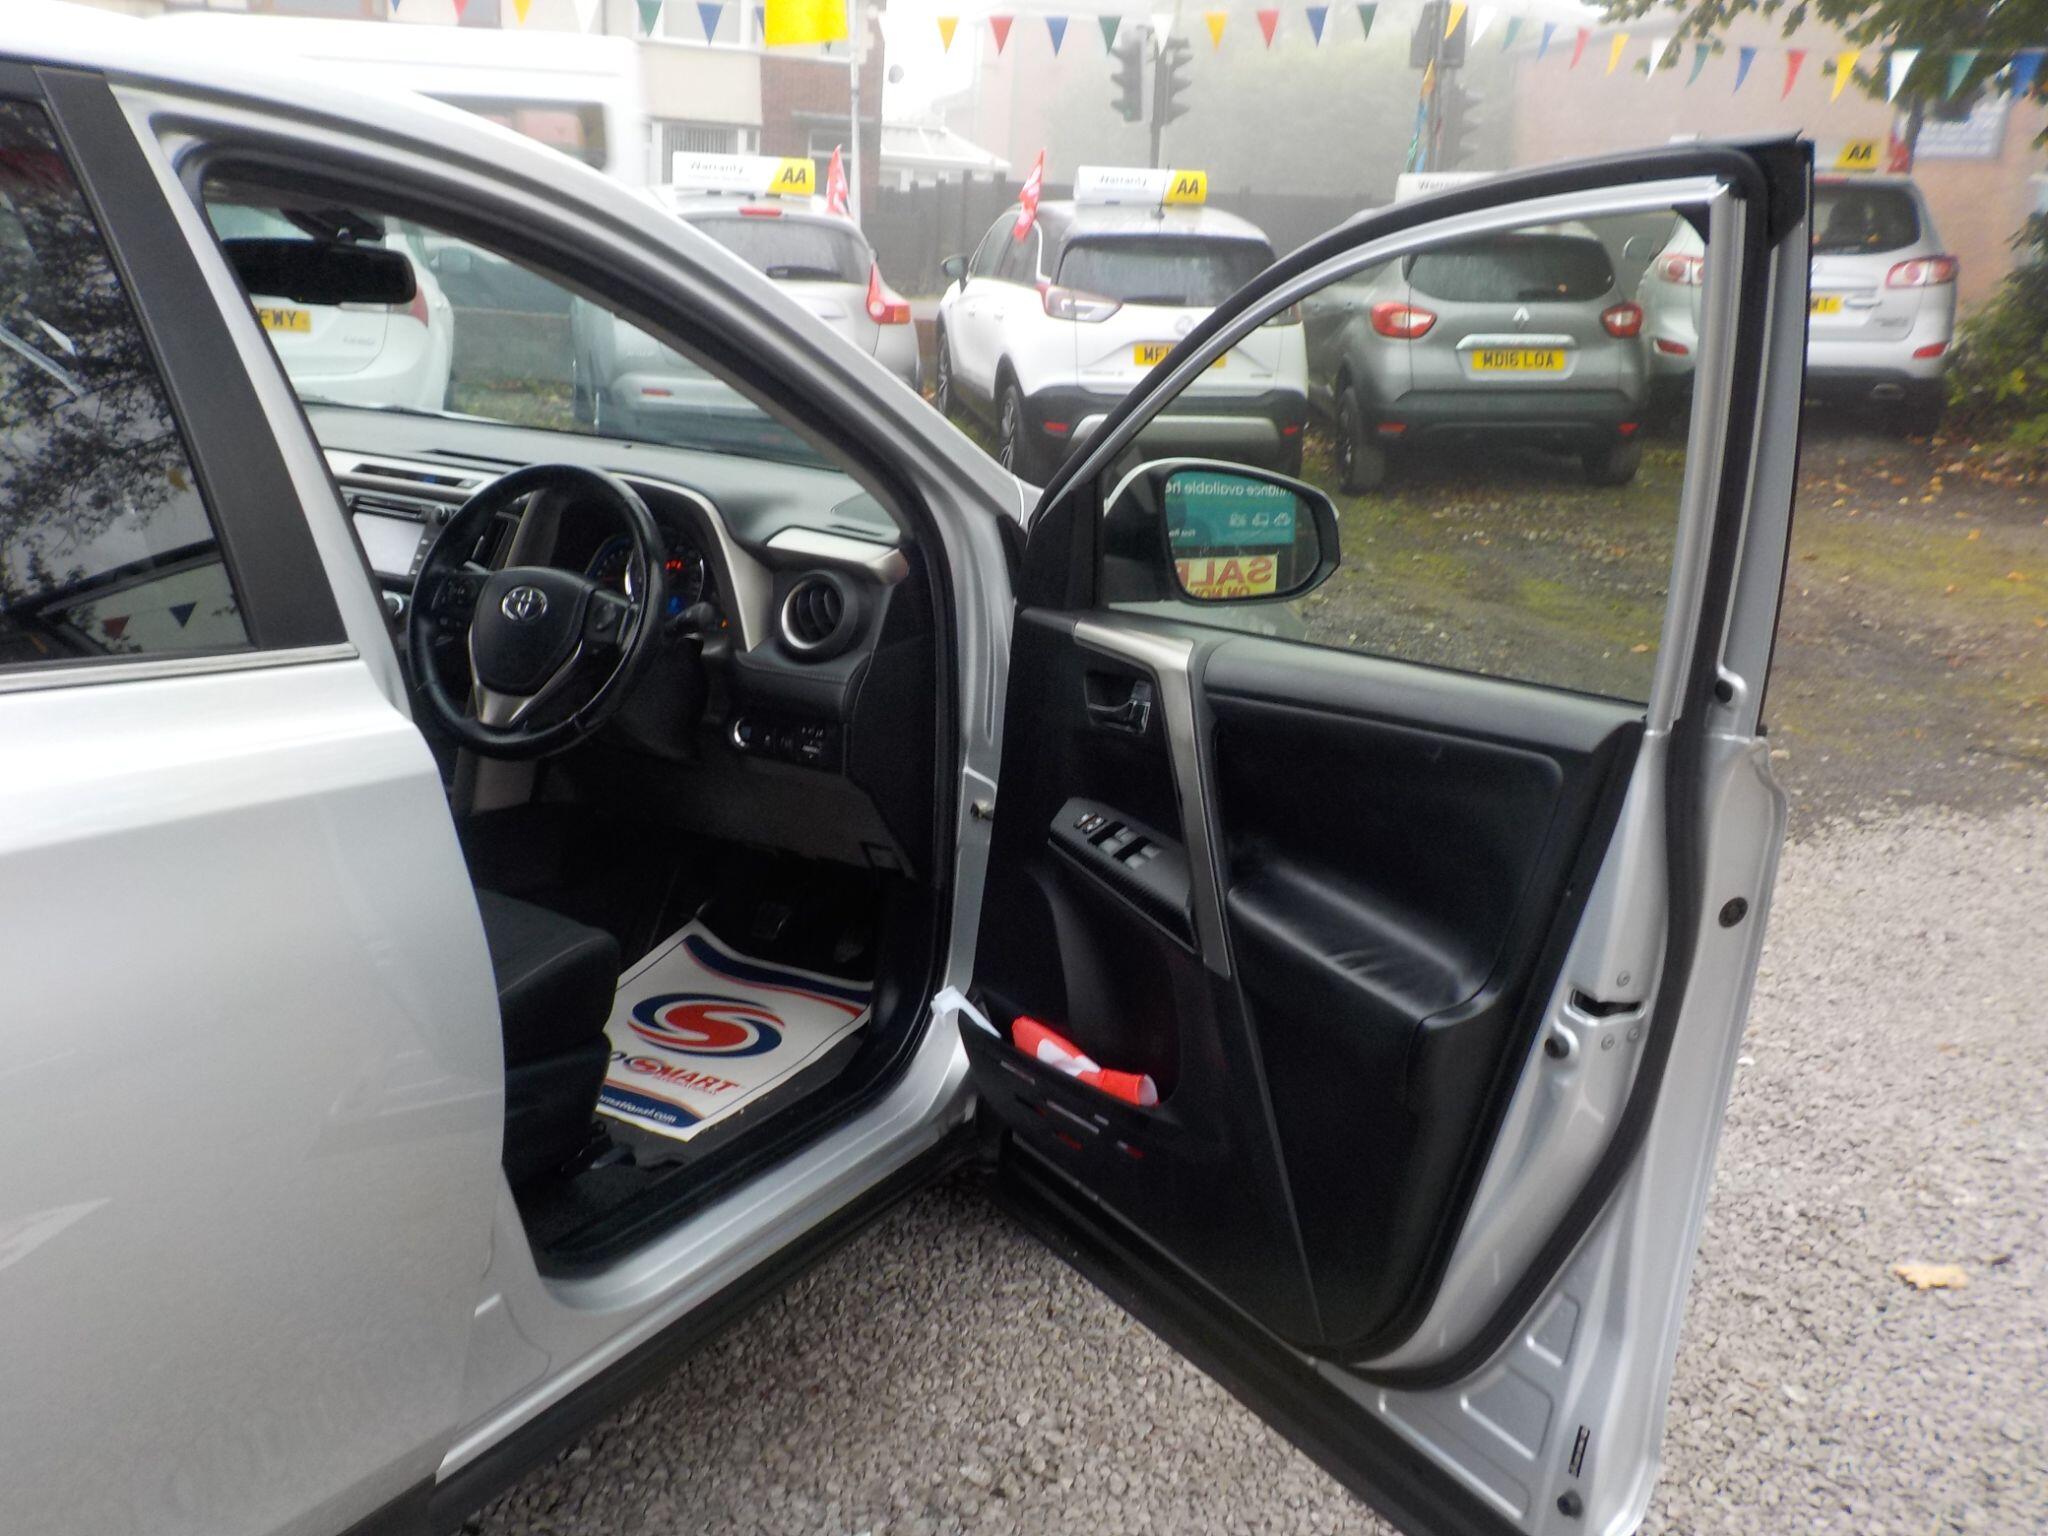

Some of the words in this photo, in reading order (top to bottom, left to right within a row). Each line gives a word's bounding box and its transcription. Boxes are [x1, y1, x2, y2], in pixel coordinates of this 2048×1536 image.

[1847, 145, 1872, 160] AA
[781, 167, 808, 184] AA
[1176, 178, 1199, 195] AA
